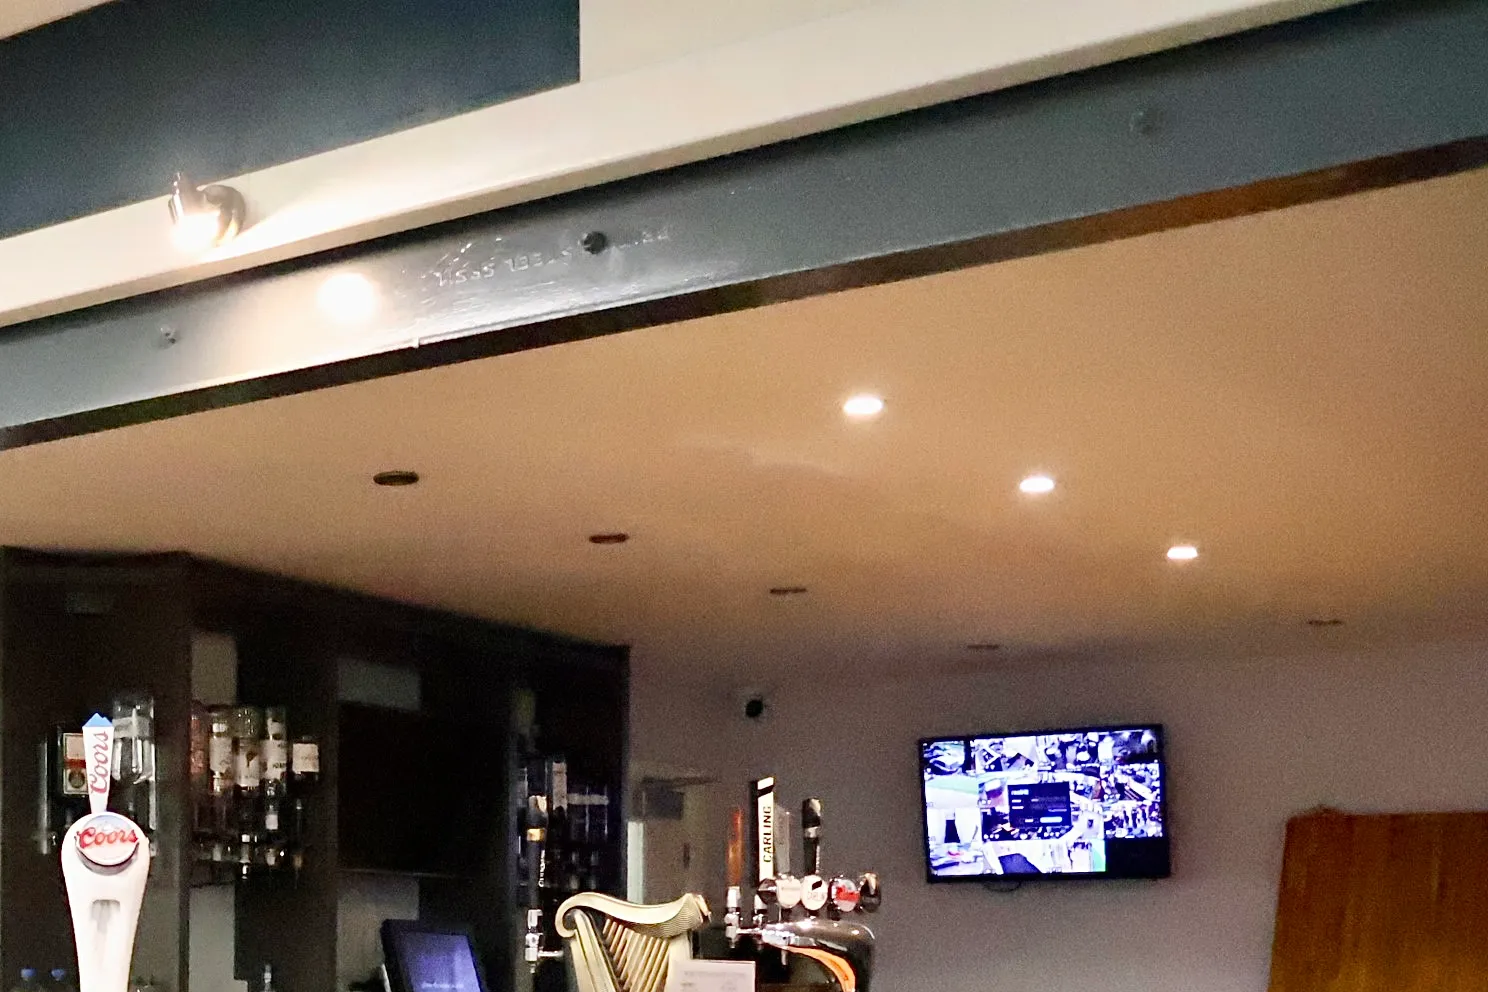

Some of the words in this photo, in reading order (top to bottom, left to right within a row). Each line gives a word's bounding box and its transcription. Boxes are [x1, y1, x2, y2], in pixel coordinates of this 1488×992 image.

[89, 730, 109, 794] Coors
[74, 826, 140, 849] Coors
[762, 805, 772, 863] CARLING
